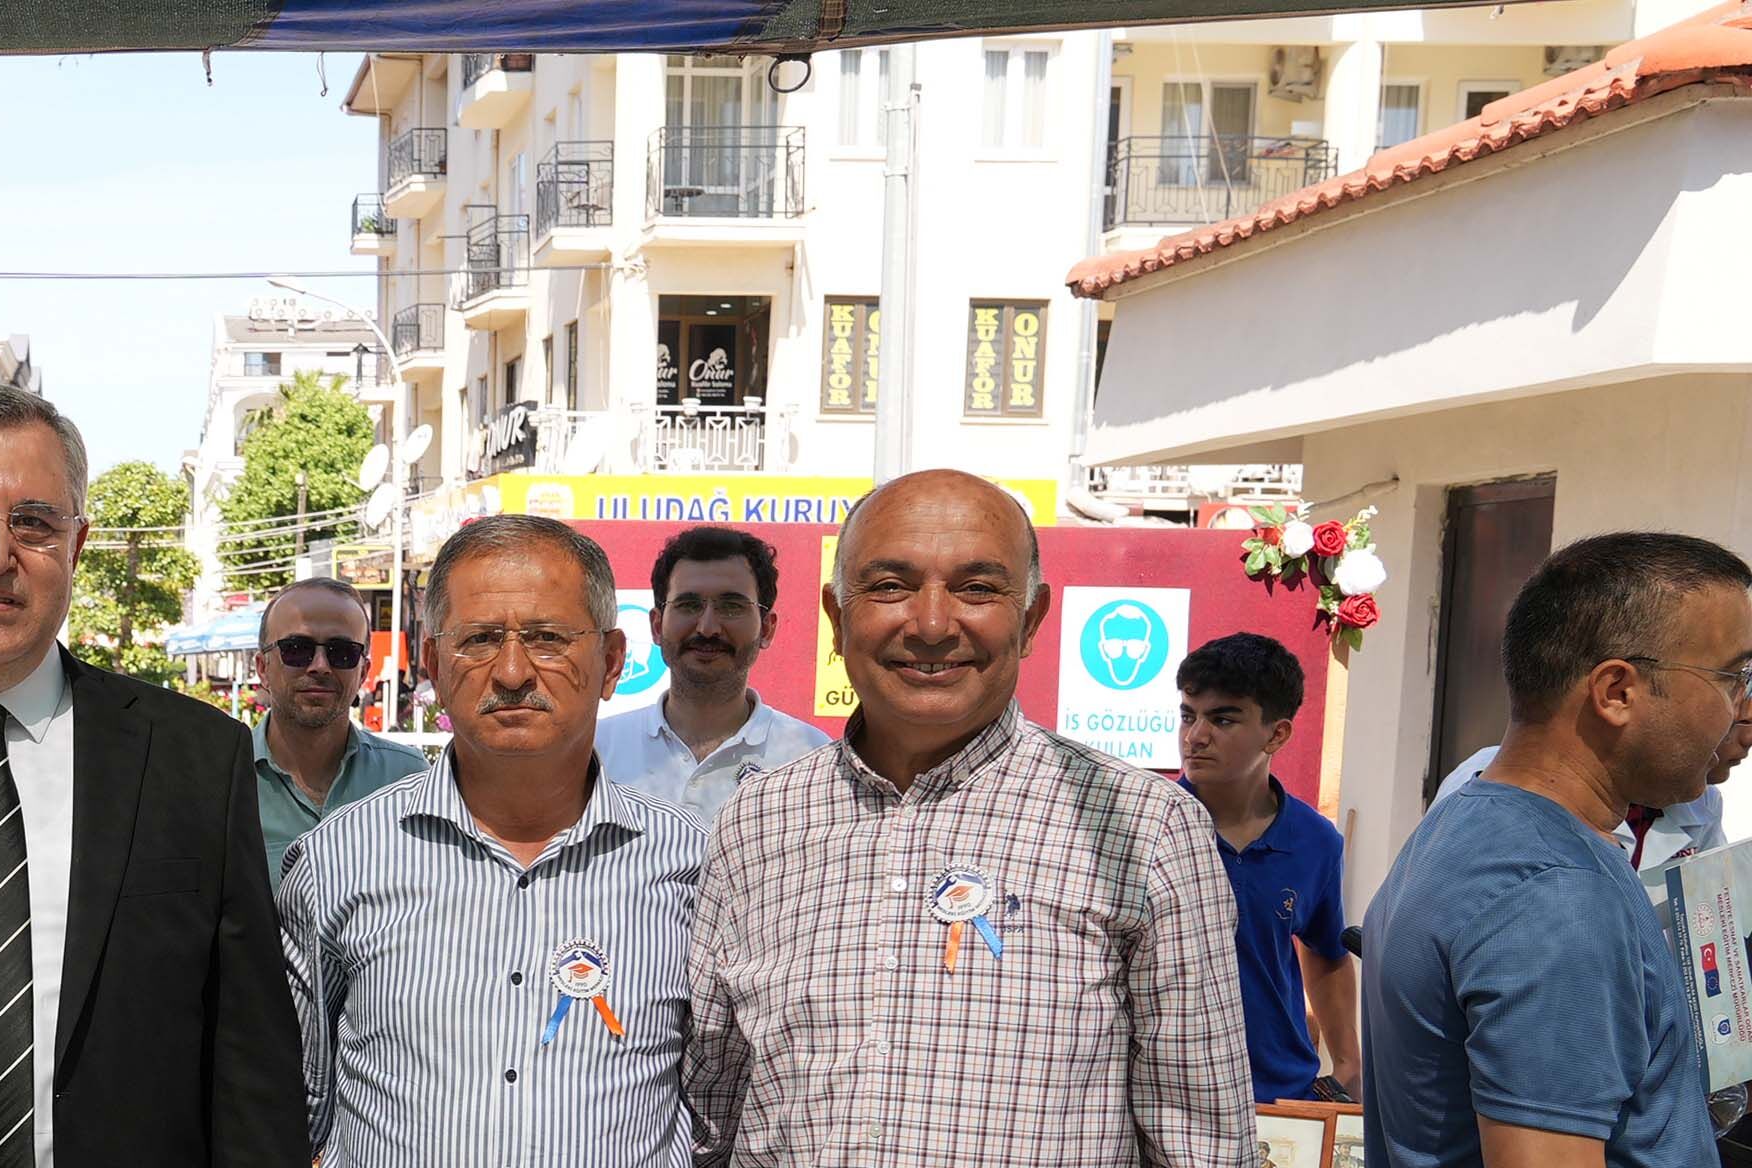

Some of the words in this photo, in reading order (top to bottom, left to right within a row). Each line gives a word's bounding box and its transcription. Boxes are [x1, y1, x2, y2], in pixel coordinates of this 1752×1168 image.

[1010, 312, 1039, 406] ONUR
[598, 488, 729, 521] ULUDAĞ
[826, 686, 854, 705] GÜ
[1087, 708, 1175, 733] GÖZLÜĞÜ
